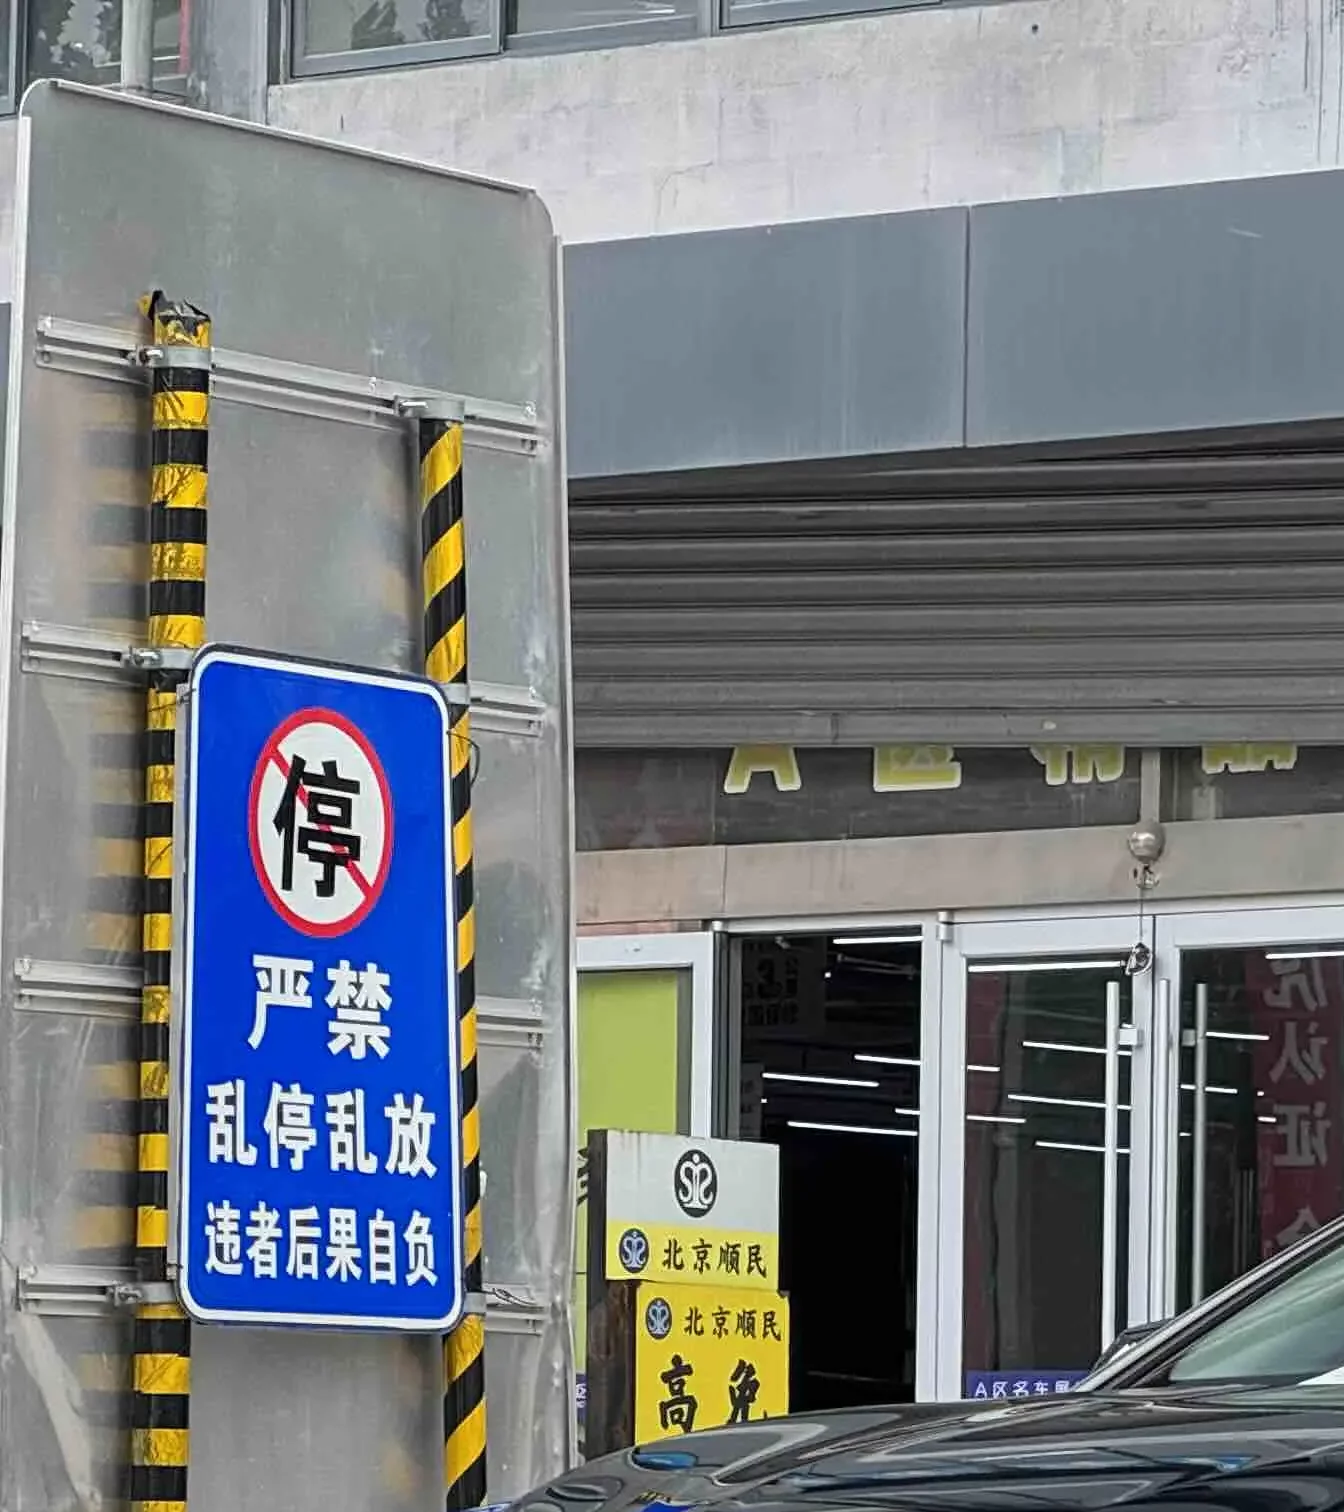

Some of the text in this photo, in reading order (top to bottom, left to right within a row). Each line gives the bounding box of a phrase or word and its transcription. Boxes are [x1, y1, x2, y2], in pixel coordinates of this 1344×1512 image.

[273, 753, 362, 897] 停
[247, 953, 393, 1060] 严禁
[205, 1078, 438, 1179] 乱停乱放
[204, 1199, 439, 1287] 违者后果自负
[662, 1238, 768, 1278] 北京顺民
[684, 1305, 781, 1341] 北京顺民
